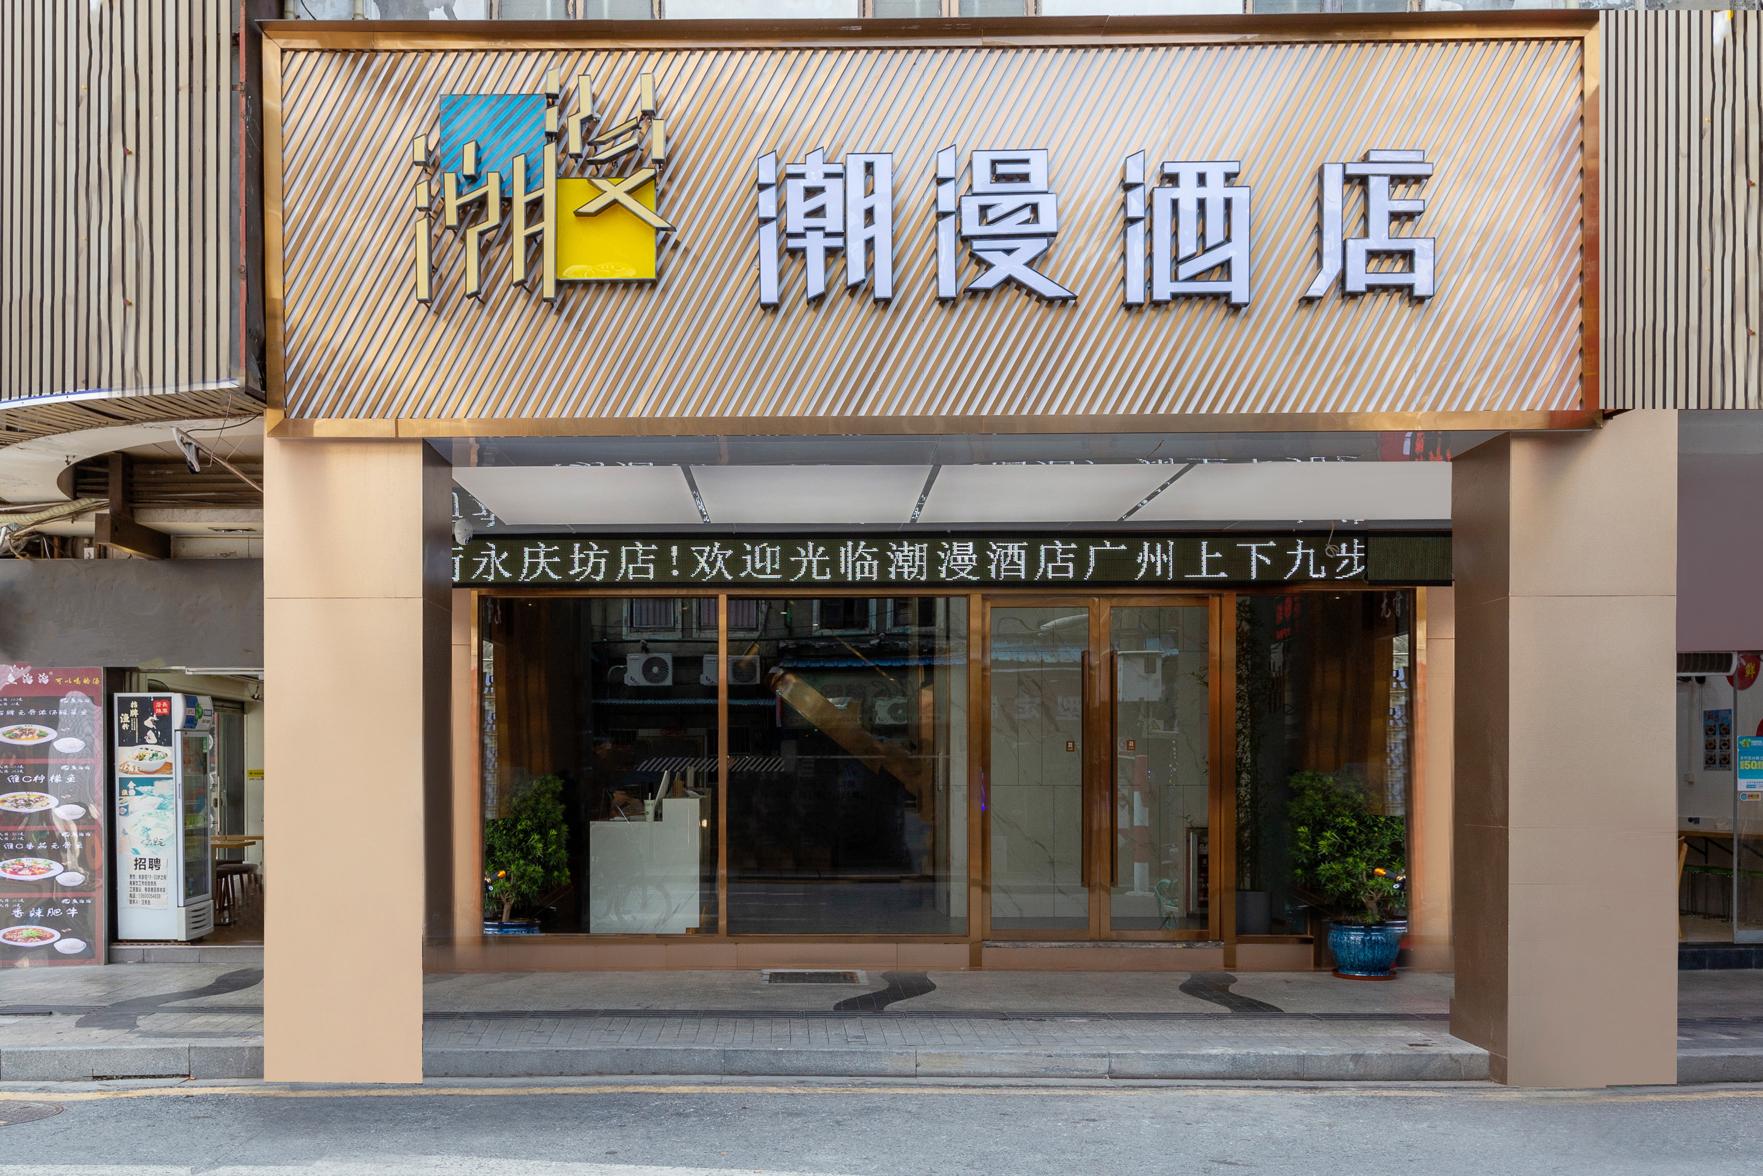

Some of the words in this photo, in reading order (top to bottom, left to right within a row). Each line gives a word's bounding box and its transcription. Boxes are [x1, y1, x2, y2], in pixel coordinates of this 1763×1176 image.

[757, 143, 1436, 306] 潮漫酒店
[133, 857, 161, 871] 招聘
